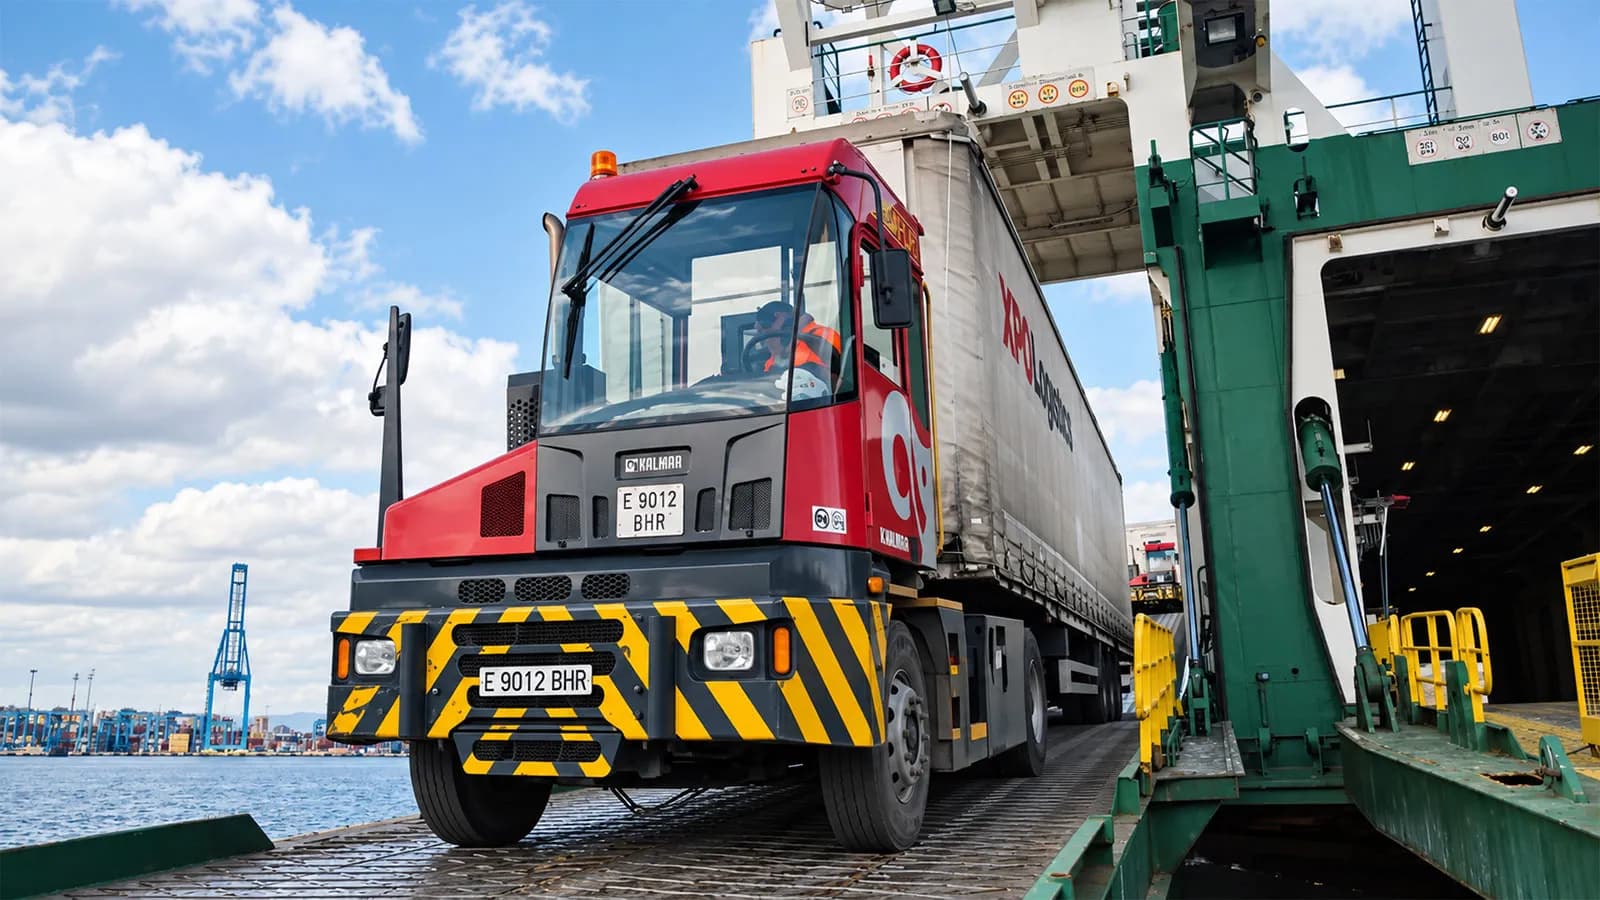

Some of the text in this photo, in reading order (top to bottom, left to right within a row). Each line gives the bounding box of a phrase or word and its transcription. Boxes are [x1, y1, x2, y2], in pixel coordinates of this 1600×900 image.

[640, 455, 682, 472] KALMAR
[623, 490, 677, 510] E 9012
[633, 513, 665, 532] BHR
[484, 669, 587, 692] E 9012 BHR
